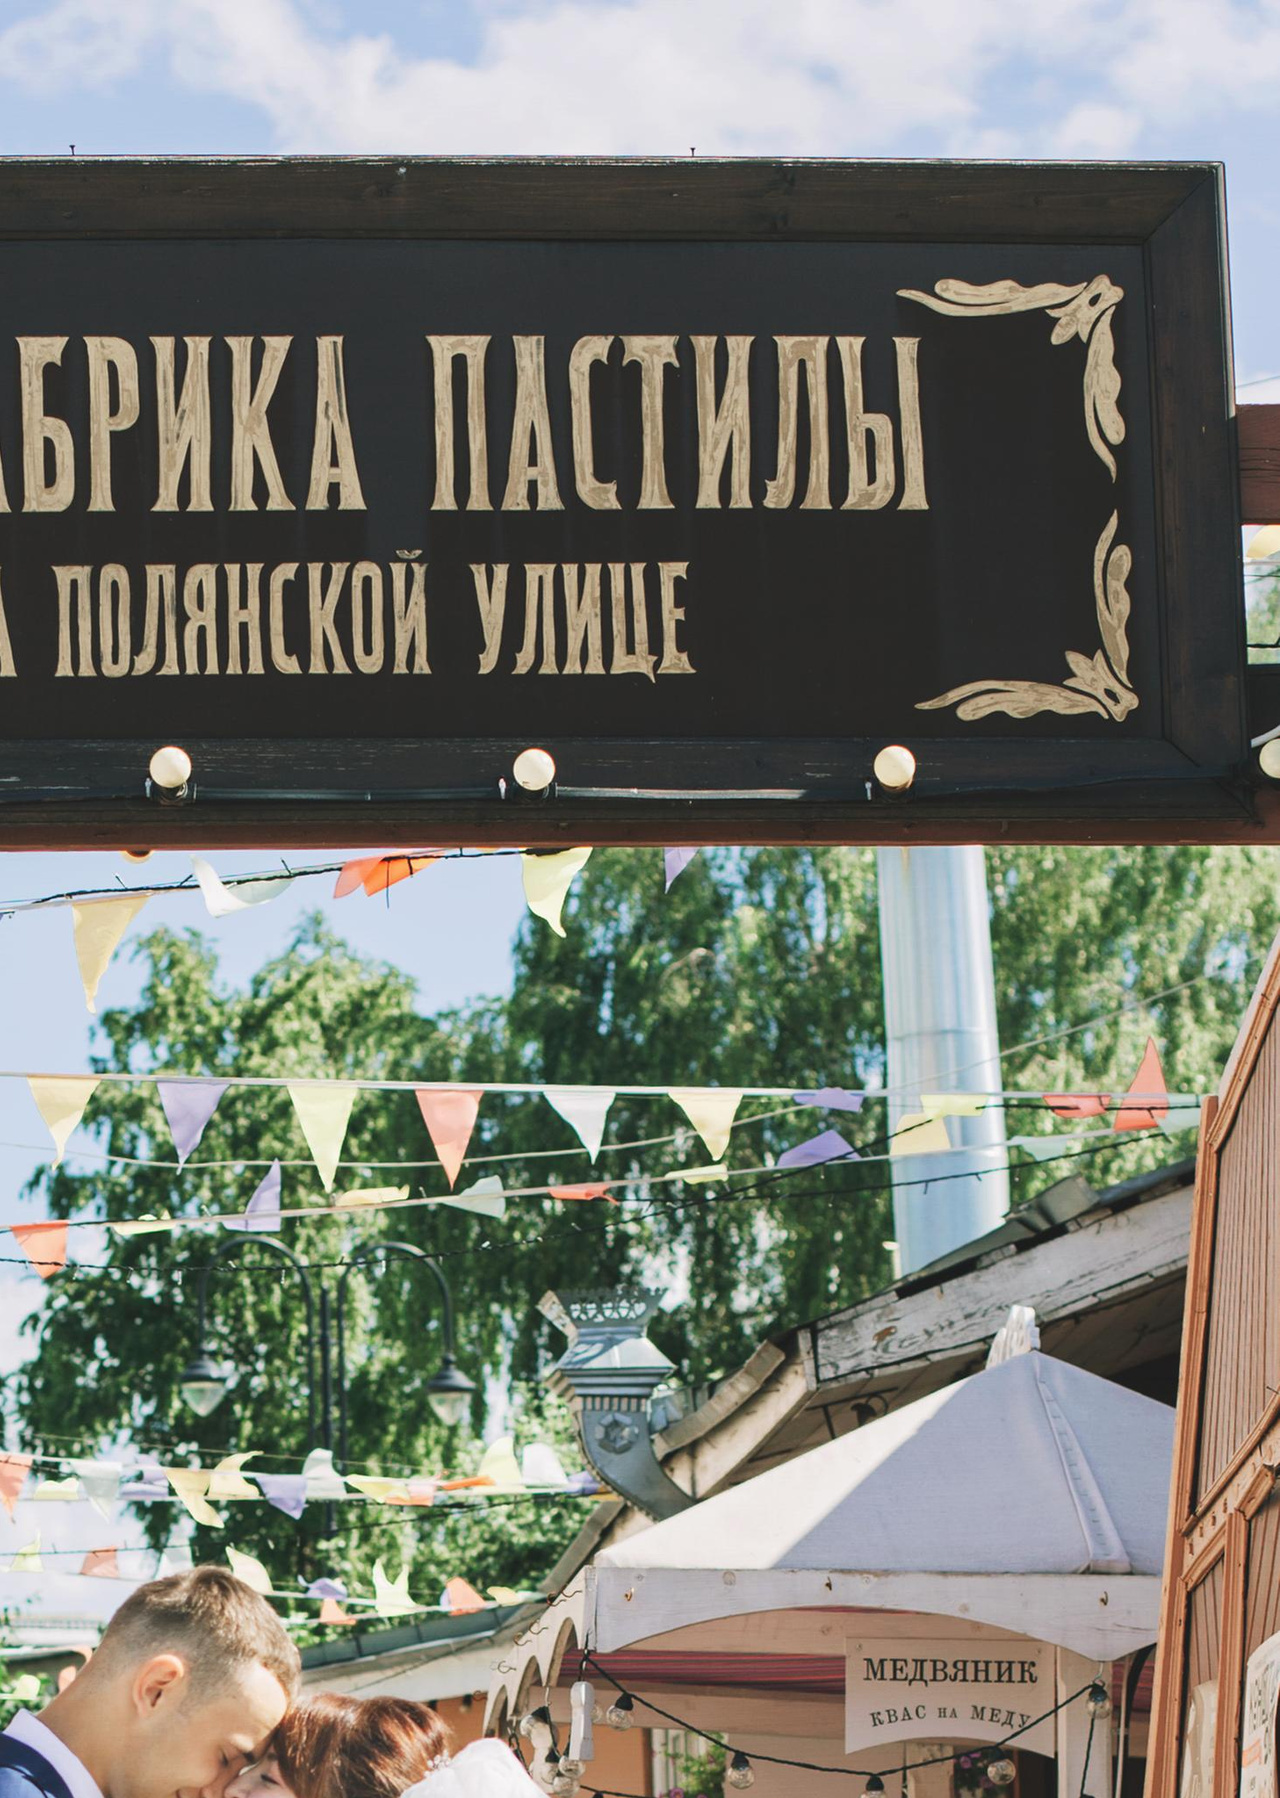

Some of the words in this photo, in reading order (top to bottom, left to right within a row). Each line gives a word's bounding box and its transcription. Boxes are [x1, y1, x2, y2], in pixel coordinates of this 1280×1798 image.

[425, 334, 930, 511] ПАСТИЛЫ
[52, 549, 431, 678] ПОЛЯНСКОЙ
[469, 561, 697, 684] УЛИЦЕ
[863, 1657, 1038, 1687] МЕДВЯНИК
[870, 1704, 927, 1727] КВАС
[937, 1707, 958, 1719] НА
[971, 1704, 1032, 1729] МЕДУ
